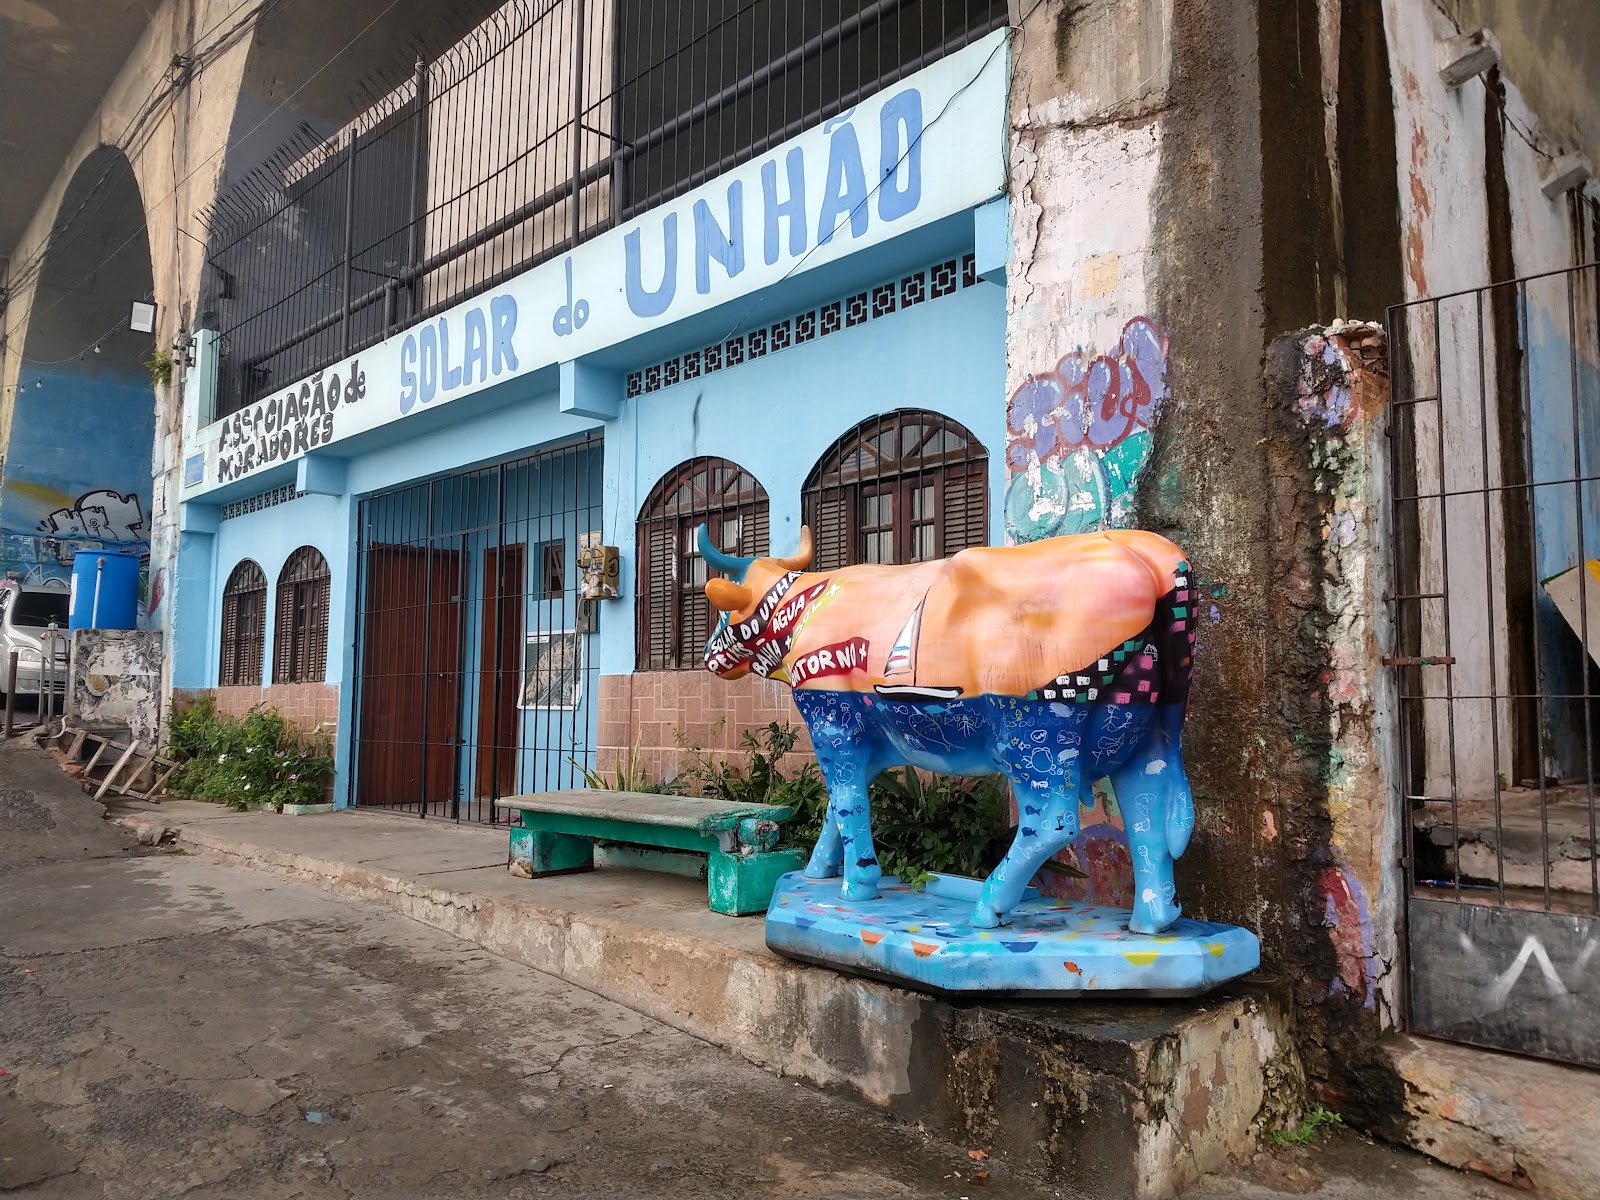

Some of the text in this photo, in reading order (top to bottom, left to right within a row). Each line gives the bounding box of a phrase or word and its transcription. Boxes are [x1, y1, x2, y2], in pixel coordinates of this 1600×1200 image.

[400, 88, 922, 415] SOLAR do UNHÃO
[344, 359, 366, 404] de
[218, 412, 334, 483] MORADORES
[711, 625, 737, 655] SOLAR
[740, 618, 760, 640] DO
[752, 639, 783, 678] BAHIA
